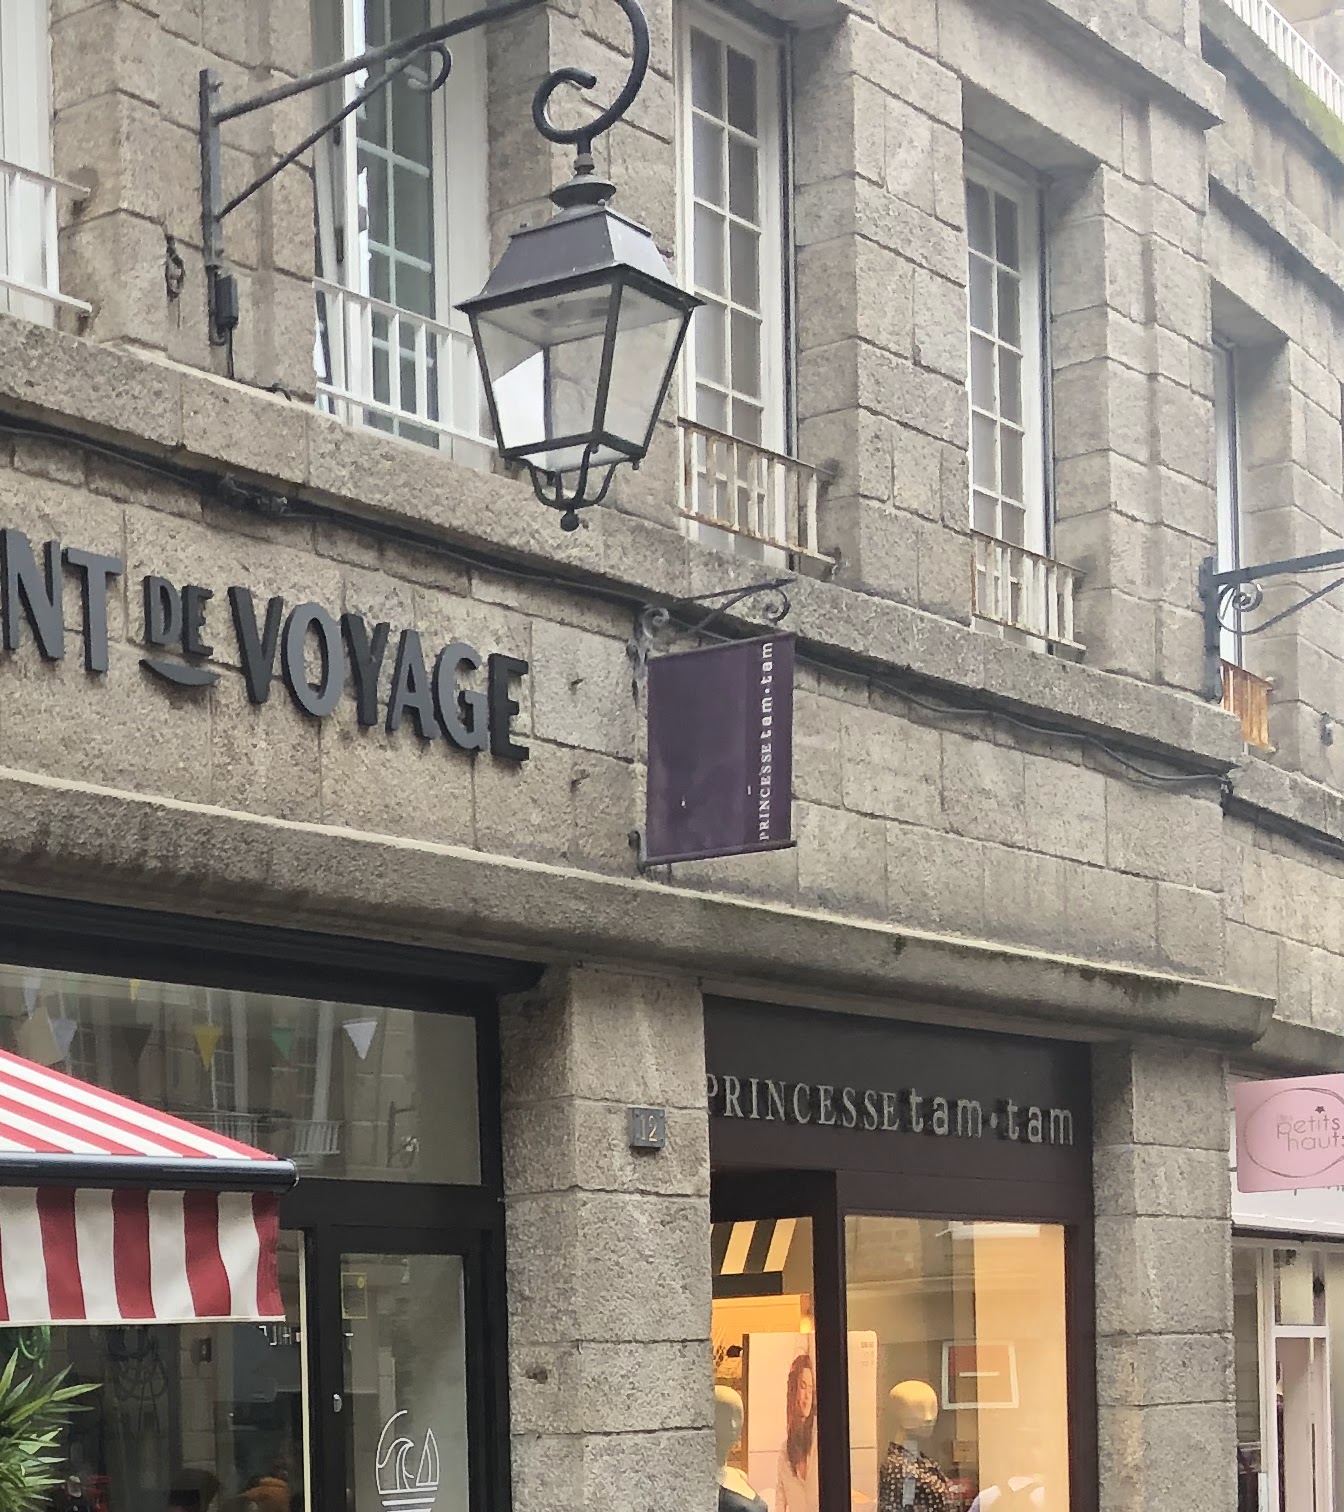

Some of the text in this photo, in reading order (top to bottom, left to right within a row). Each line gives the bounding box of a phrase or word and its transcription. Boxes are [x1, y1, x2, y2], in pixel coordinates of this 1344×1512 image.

[142, 575, 215, 657] DE
[228, 586, 530, 762] VOYAGE
[758, 743, 773, 841] PRINCESSE
[706, 1073, 900, 1132] PRINCESSE
[1276, 1114, 1341, 1140] petits
